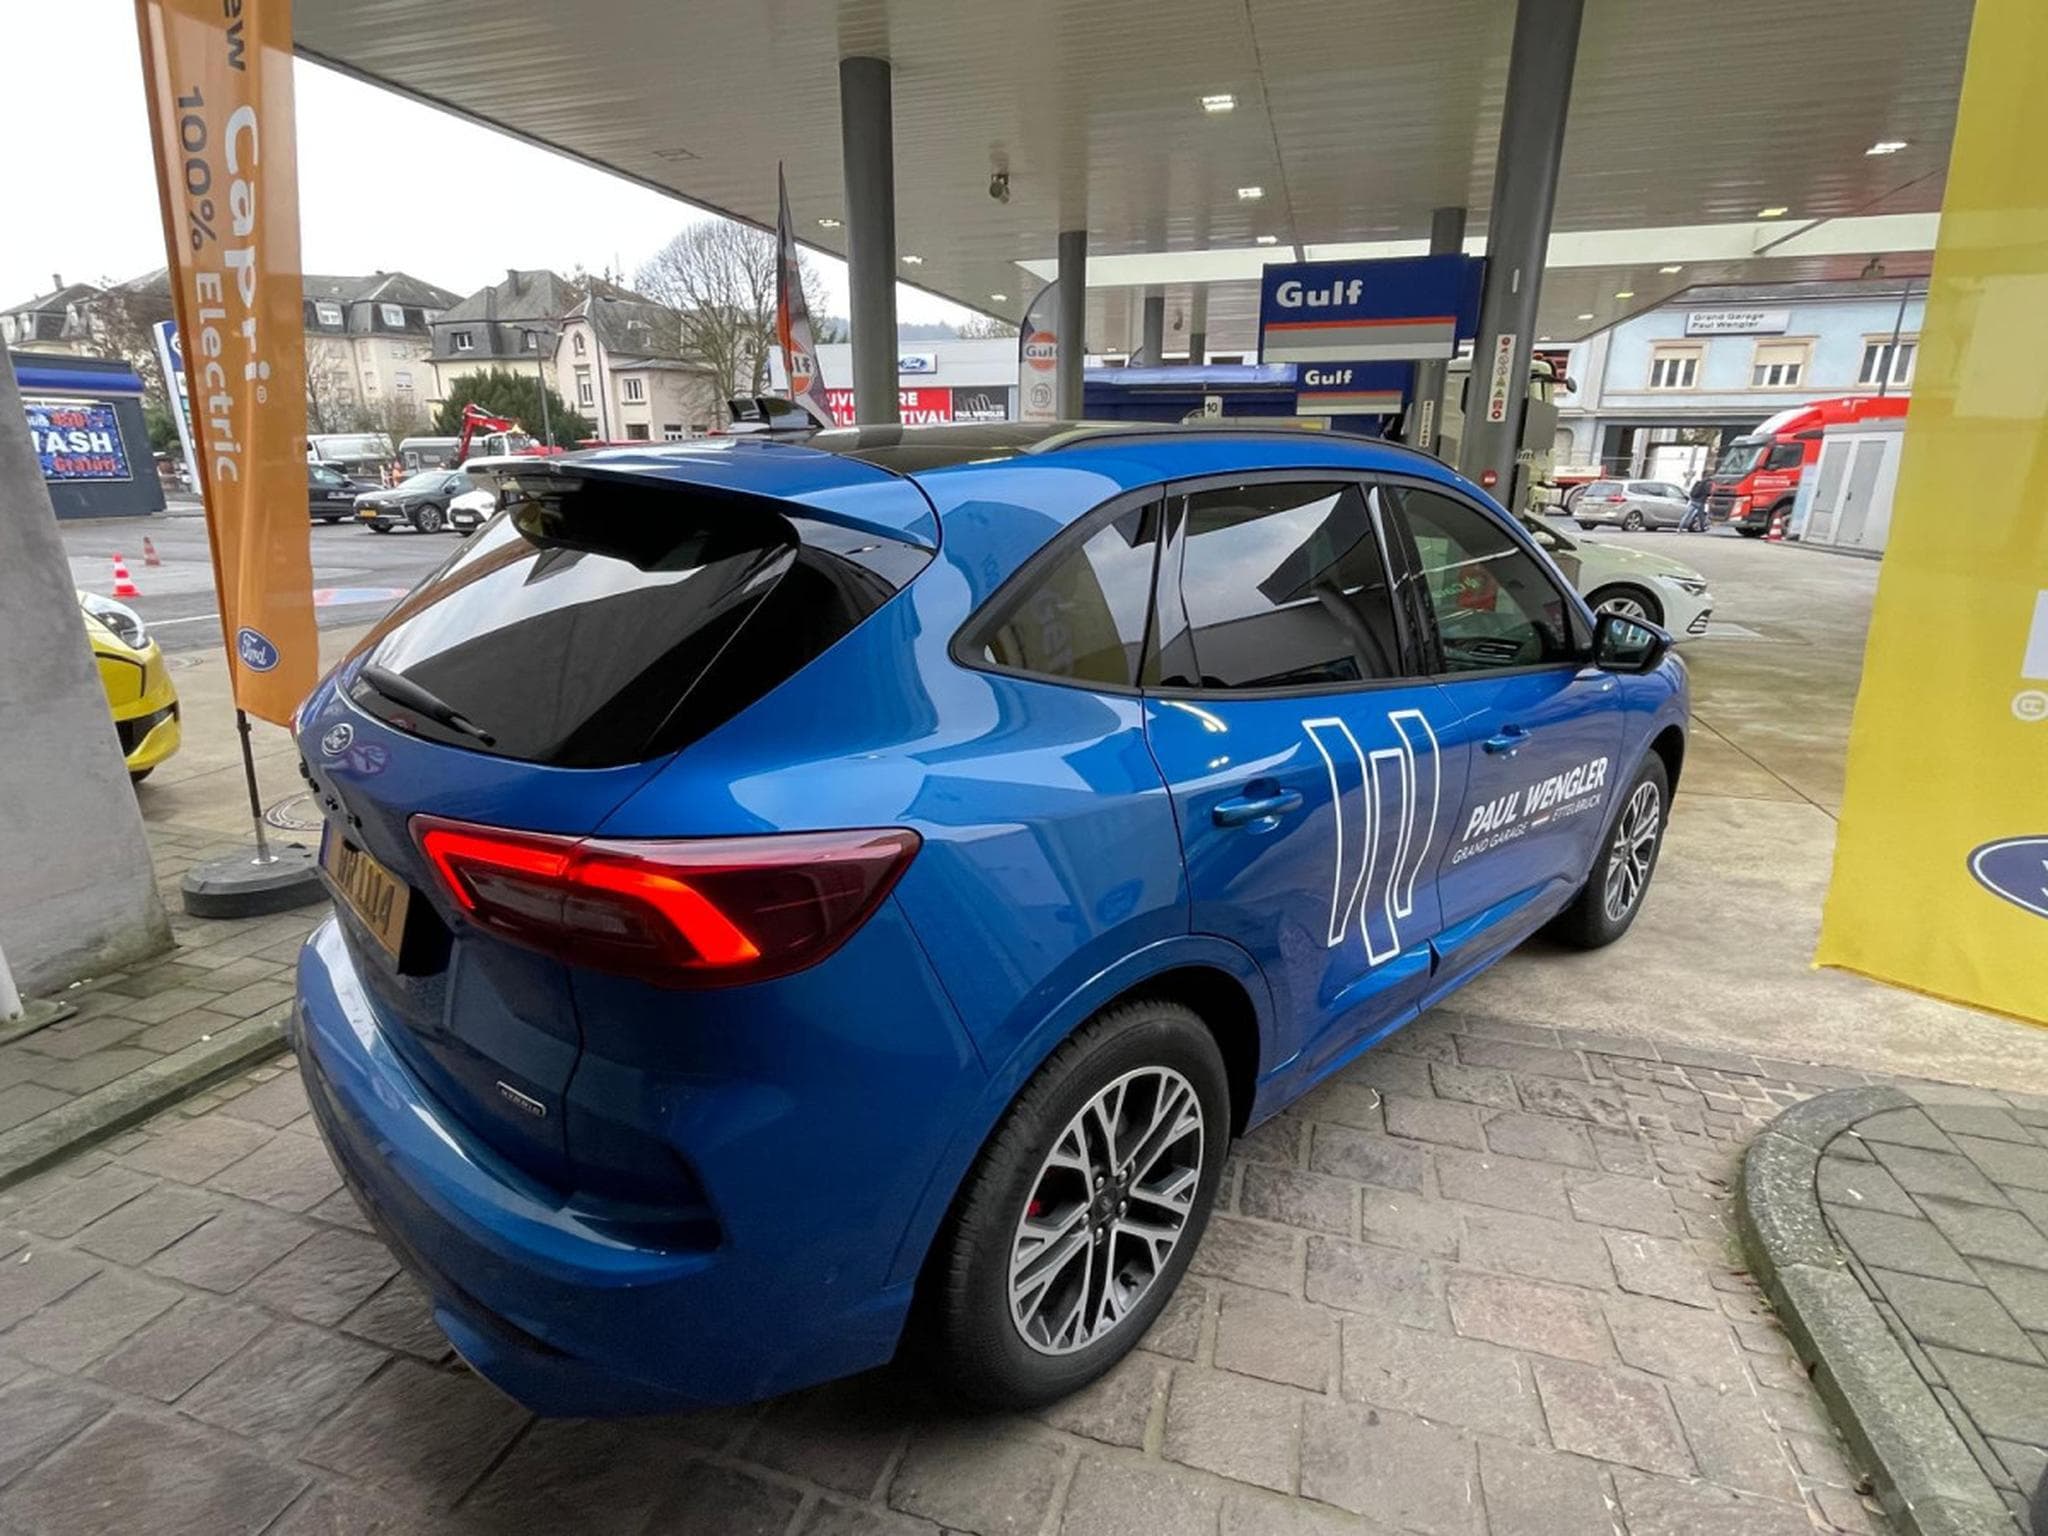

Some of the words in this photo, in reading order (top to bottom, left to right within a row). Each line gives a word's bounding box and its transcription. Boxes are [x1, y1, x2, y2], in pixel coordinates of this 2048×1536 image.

[178, 86, 216, 251] 100%
[1276, 280, 1363, 307] Gulf
[1694, 313, 1725, 321] Grand
[1728, 313, 1764, 321] Garage
[196, 273, 241, 481] Electric
[1305, 369, 1353, 386] Gulf
[1462, 791, 1521, 842] PAUL
[1523, 756, 1609, 817] WENGLER
[1452, 837, 1489, 864] GRAND
[1490, 820, 1529, 848] GARAGE
